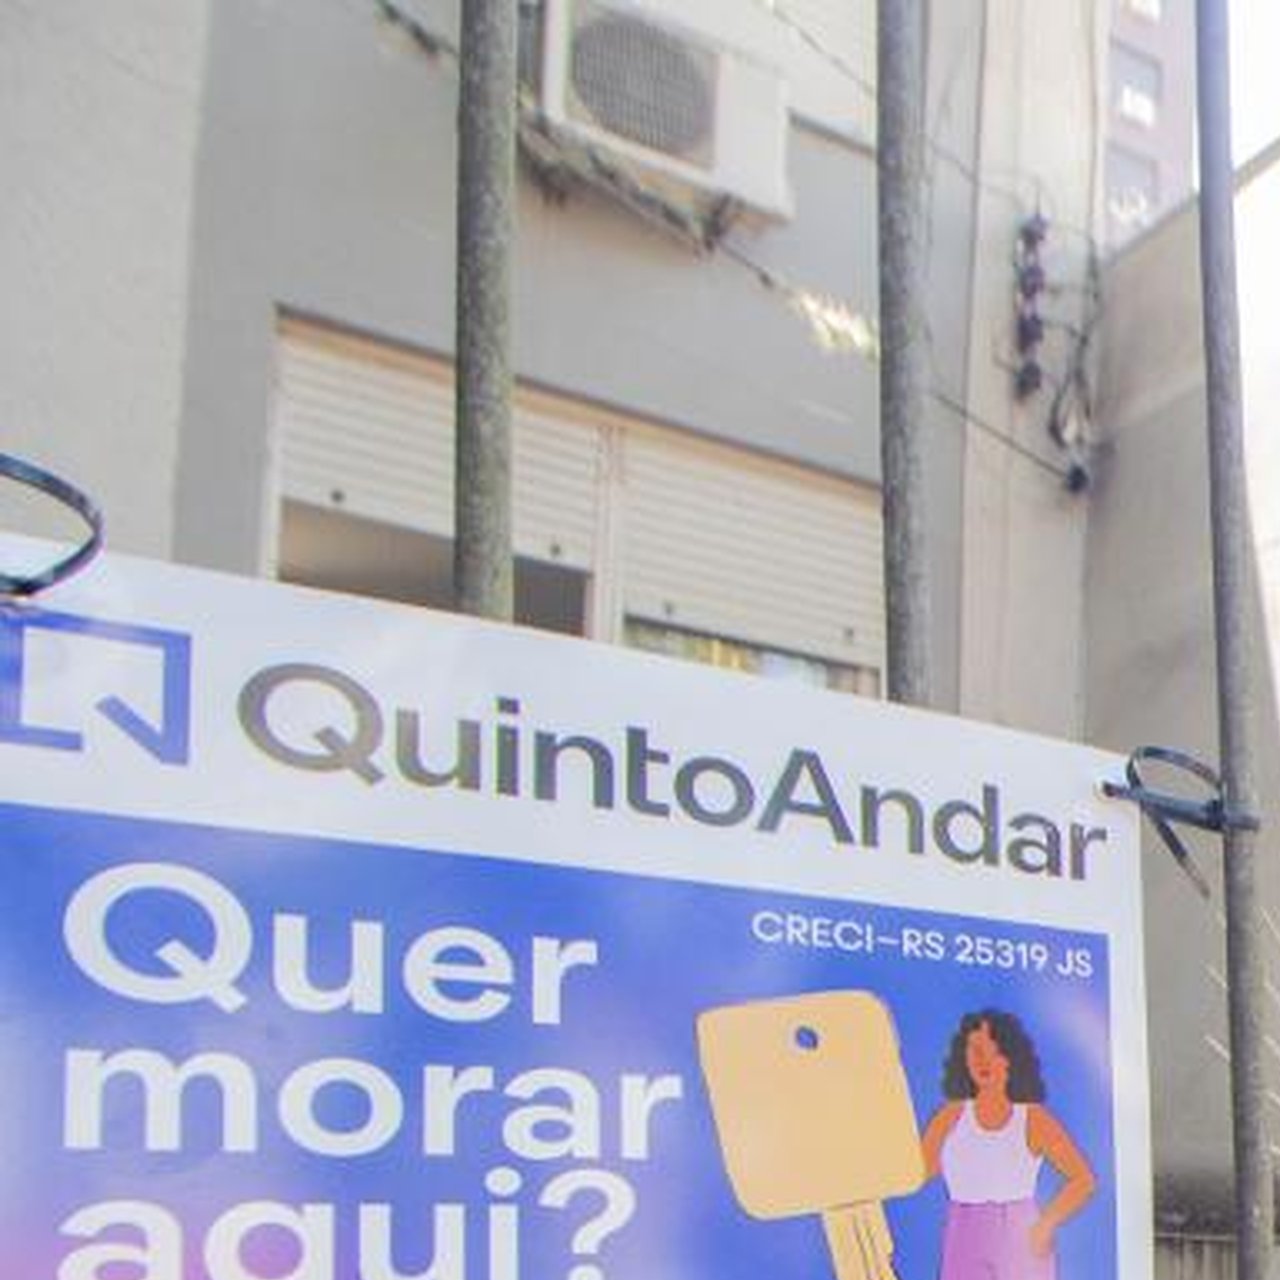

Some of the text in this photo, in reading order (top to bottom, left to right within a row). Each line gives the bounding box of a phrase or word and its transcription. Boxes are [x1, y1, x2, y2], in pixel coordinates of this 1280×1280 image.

[236, 660, 1108, 884] QuintoAndar
[62, 862, 599, 1026] Quer
[954, 934, 1049, 972] 25319
[1055, 949, 1094, 978] JS
[61, 1045, 682, 1162] morar
